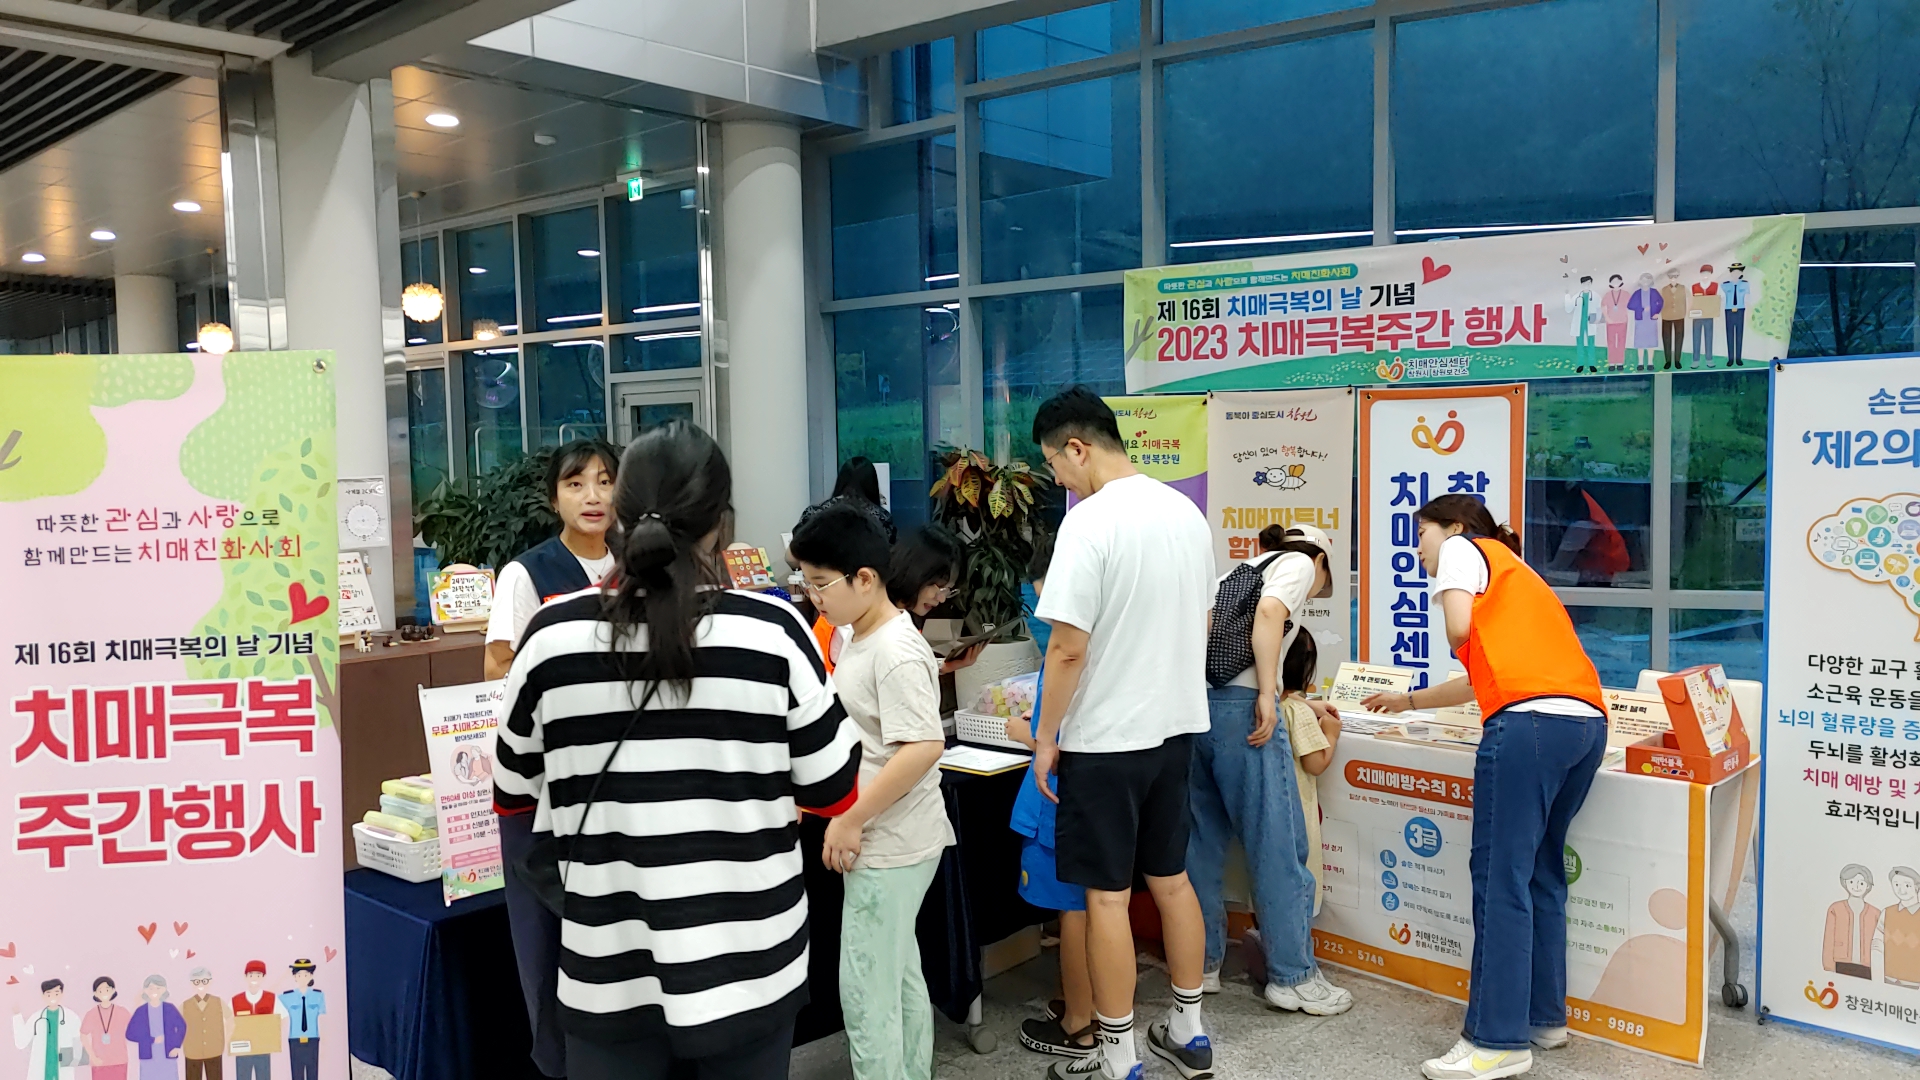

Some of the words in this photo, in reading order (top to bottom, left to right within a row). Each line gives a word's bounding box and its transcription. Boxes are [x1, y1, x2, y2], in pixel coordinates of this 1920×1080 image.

[1187, 279, 1212, 290] 관심과
[1215, 276, 1248, 287] 사랑으로
[1291, 266, 1351, 280] 치매친화사회
[1157, 300, 1176, 322] 제
[1182, 297, 1220, 321] 16회
[1227, 287, 1332, 318] 치매극복의
[1341, 286, 1363, 310] 날
[1370, 282, 1415, 308] 기념
[1157, 324, 1228, 362] 2023
[1238, 309, 1454, 357] 치매극복주간
[1464, 304, 1547, 346] 행사
[1408, 356, 1469, 369] 치매안심센터
[1226, 411, 1250, 420] 동북아
[1252, 410, 1284, 420] 중심도시
[1142, 439, 1180, 450] 치매극복
[1233, 450, 1257, 463] 당신이
[1260, 447, 1277, 457] 있어
[1281, 445, 1328, 461] 행복합니다!
[1142, 454, 1180, 465] 행복창원
[36, 514, 99, 533] 따뜻한
[105, 507, 181, 532] 관심과
[188, 505, 280, 529] 사랑으로
[1222, 506, 1339, 530] 치매파트너
[24, 545, 132, 566] 함께만드는
[138, 534, 302, 562] 치매친화사회
[14, 643, 40, 666] 제
[48, 640, 96, 664] 16회
[105, 636, 227, 662] 치매극복의
[236, 634, 260, 657] 날
[268, 632, 313, 655] 기념
[1808, 654, 1864, 676] 다양한
[1869, 659, 1907, 679] 교구
[1807, 683, 1862, 705] 소근육
[15, 678, 316, 763] 치매극복
[443, 714, 461, 722] 치매가
[1778, 709, 1815, 729] 뇌의
[1821, 711, 1896, 738] 혈류량을
[431, 725, 449, 736] 무료
[1808, 740, 1864, 764] 두뇌를
[1357, 767, 1446, 797] 치매예방수칙
[1803, 768, 1839, 789] 치매
[1844, 773, 1883, 796] 예방
[1889, 778, 1906, 799] 및
[462, 790, 475, 799] 이상
[17, 781, 322, 868] 주간행사
[1409, 824, 1438, 849] 3금
[1323, 940, 1344, 955] 225
[1357, 949, 1385, 967] 5748
[1608, 1016, 1645, 1037] 9988
[1024, 1036, 1053, 1052] crocs
